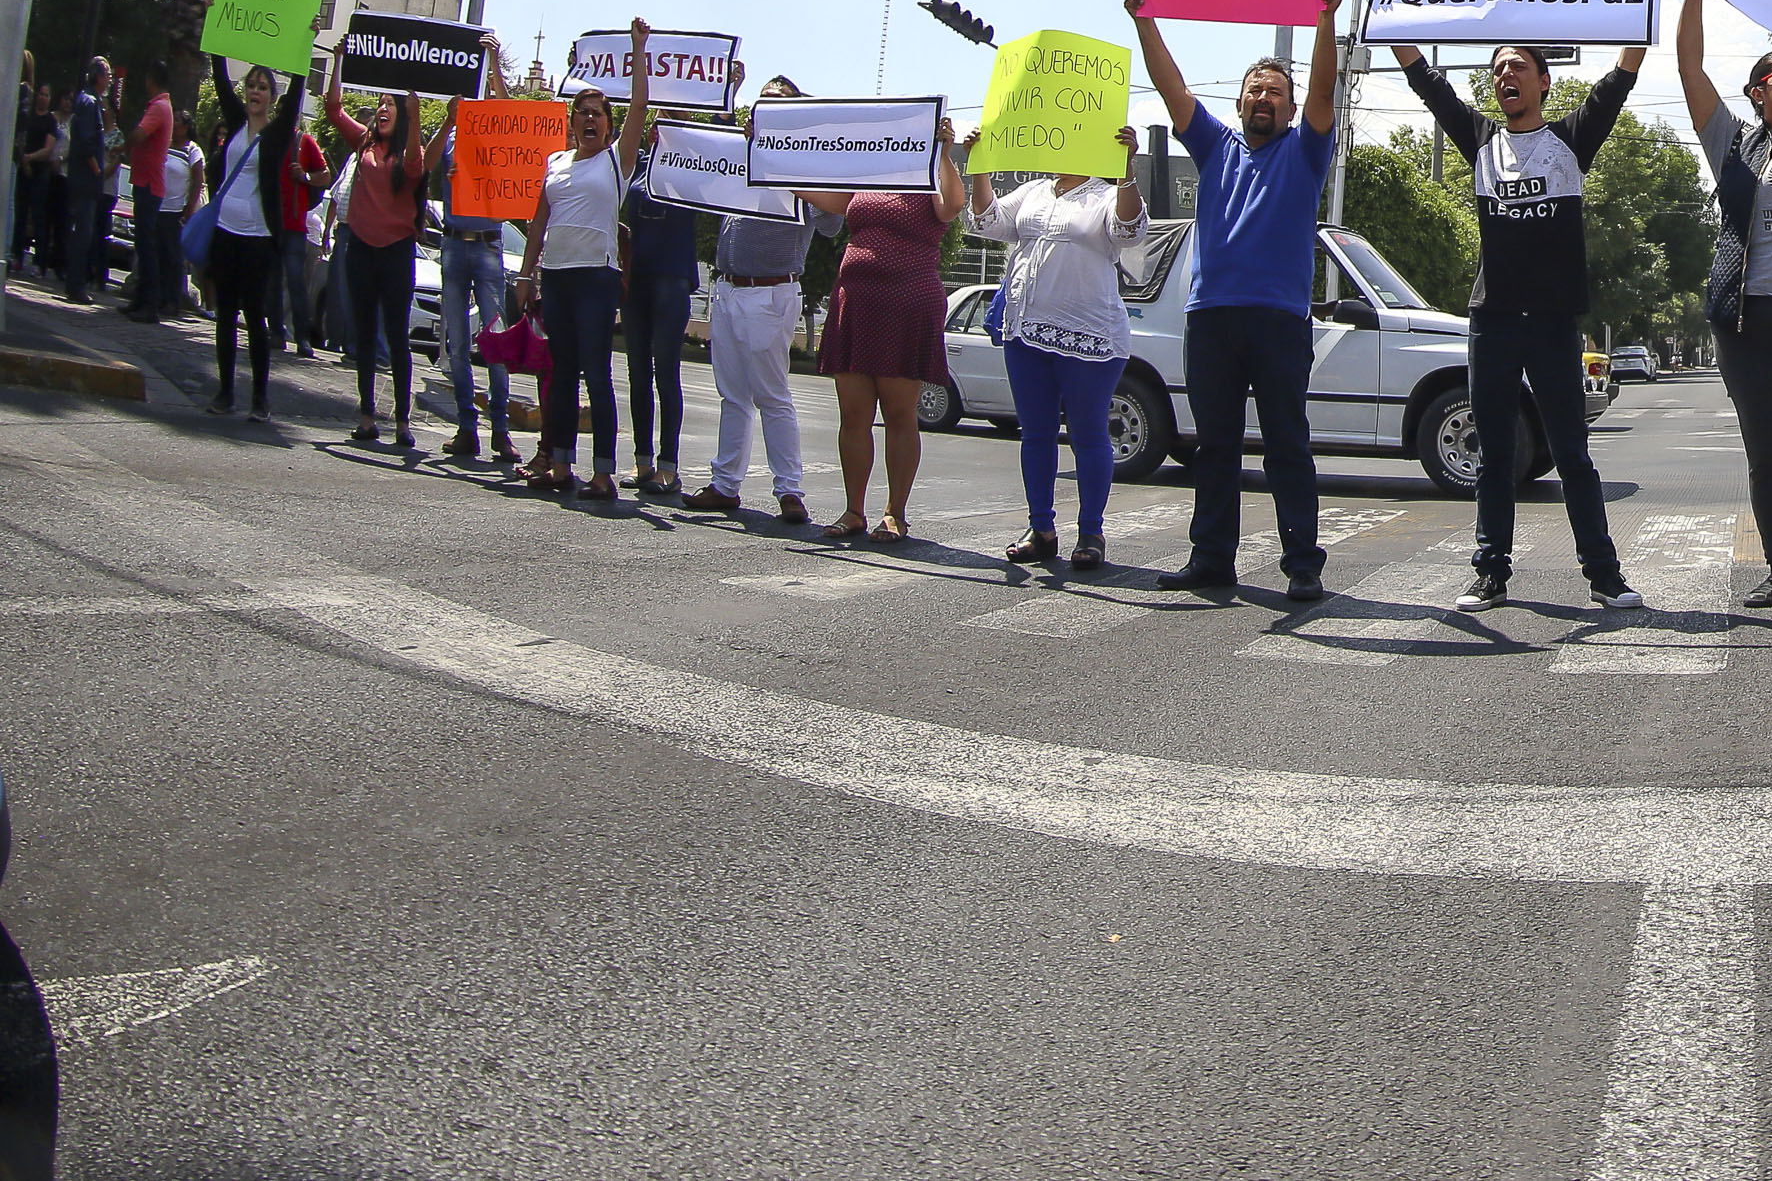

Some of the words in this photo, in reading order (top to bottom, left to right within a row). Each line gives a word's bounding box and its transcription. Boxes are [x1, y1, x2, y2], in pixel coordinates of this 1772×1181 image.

[216, 2, 281, 38] MENOS
[346, 33, 480, 70] #NiUnoMenos
[1024, 45, 1126, 87] QUEREMOS
[1001, 86, 1043, 116] VIVIR
[1054, 87, 1104, 114] CON
[464, 110, 528, 136] SEGURIDAD
[533, 115, 564, 138] PARA
[475, 145, 544, 168] NUESTROS
[756, 135, 926, 153] #NoSonTresSomosTodxs
[1499, 179, 1541, 197] DEAD
[1488, 201, 1558, 219] LEGACY
